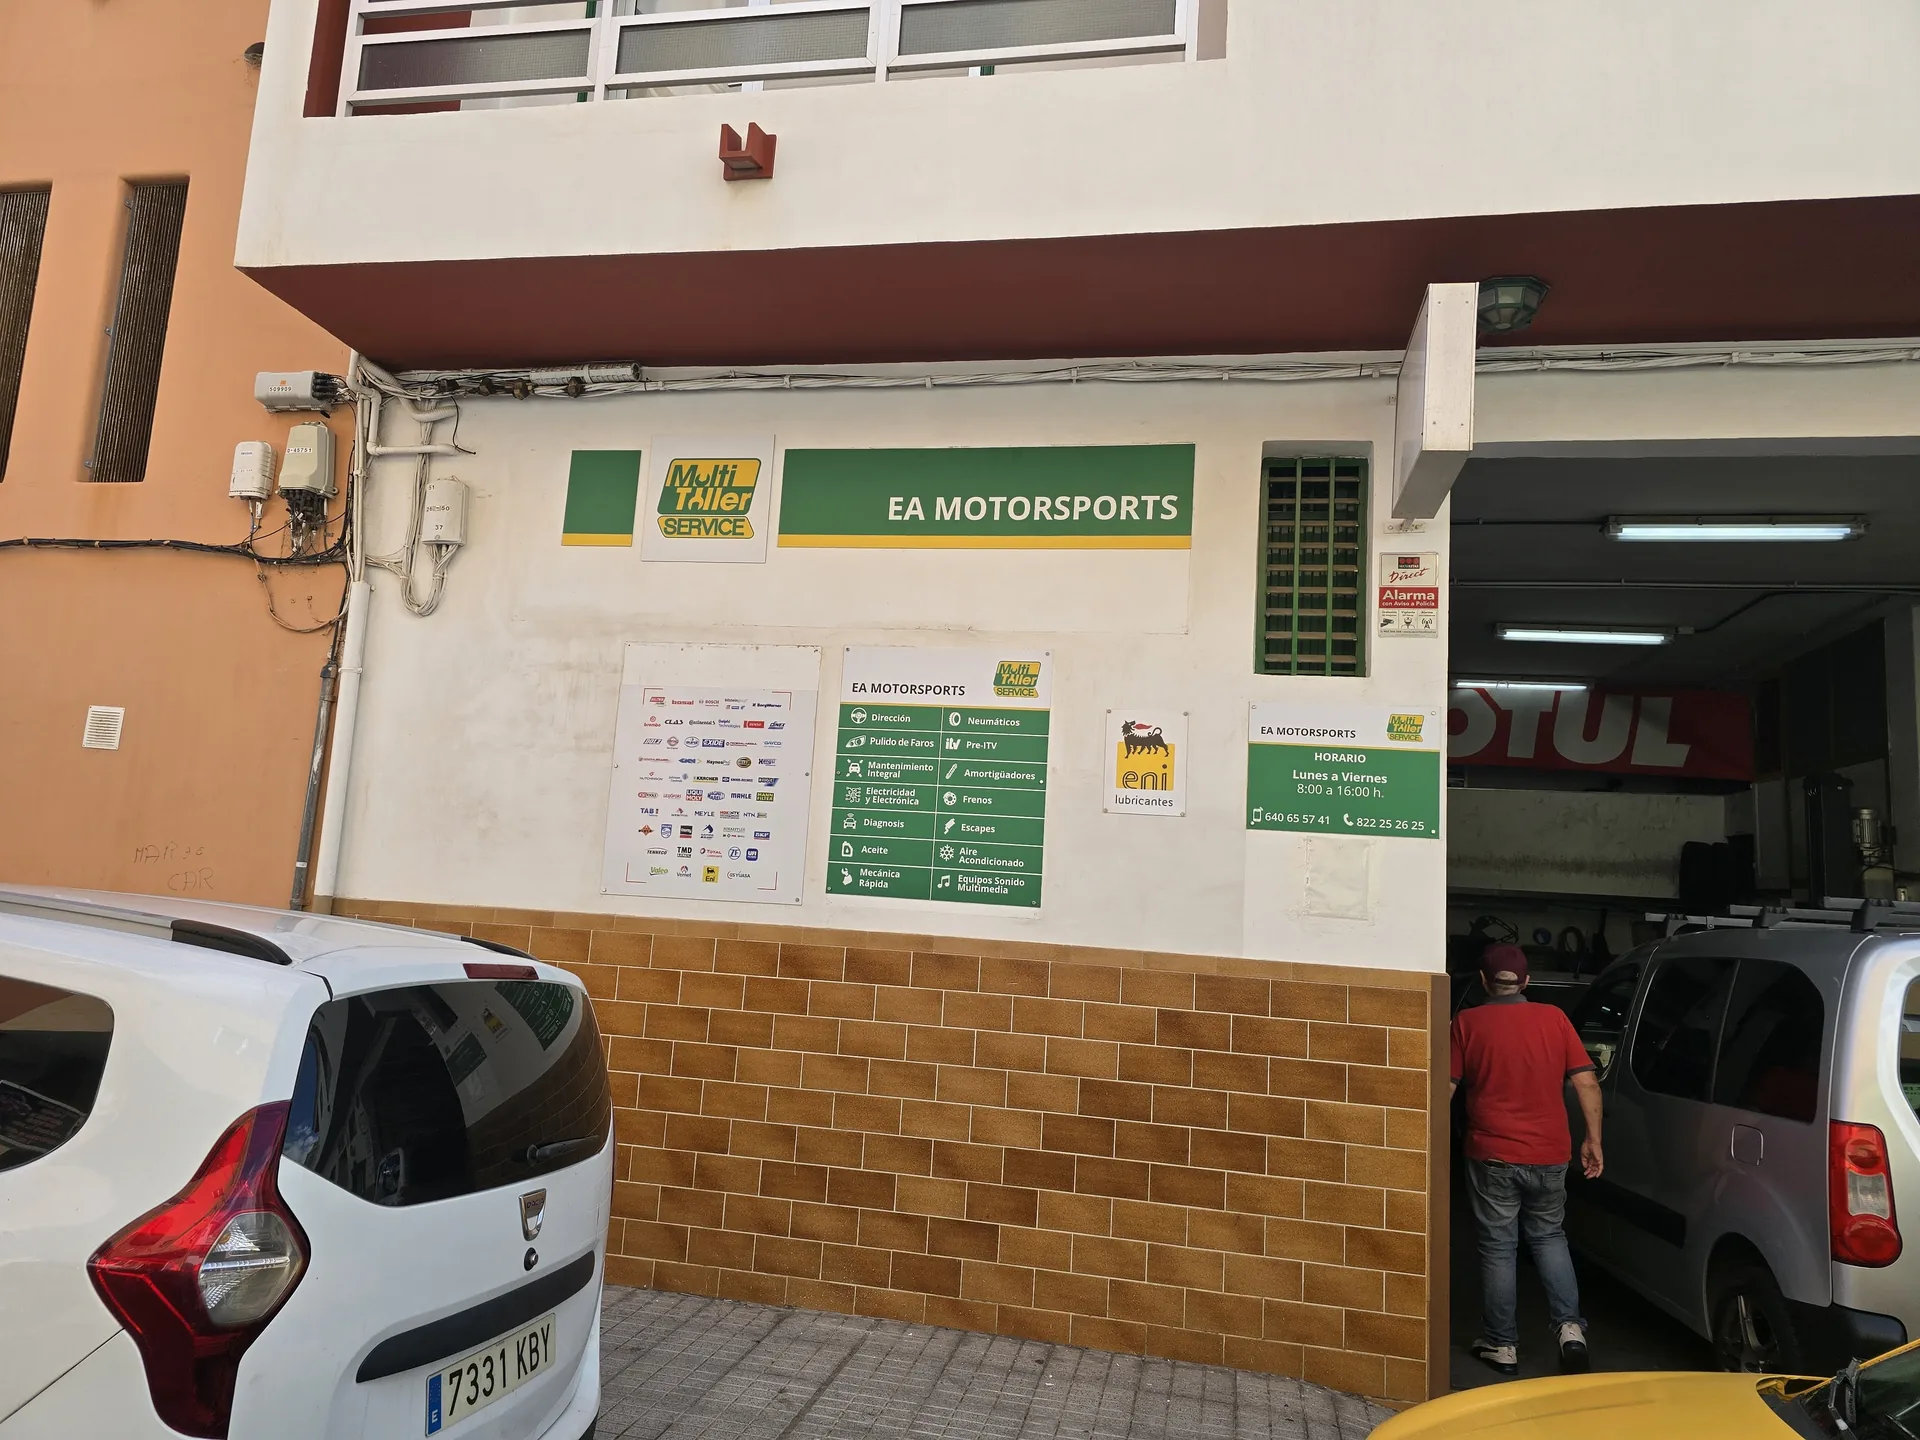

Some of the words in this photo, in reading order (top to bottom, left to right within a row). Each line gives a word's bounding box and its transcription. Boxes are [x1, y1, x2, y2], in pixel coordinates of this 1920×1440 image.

[669, 464, 738, 487] Multi
[675, 487, 753, 512] Taller
[887, 495, 926, 521] EA
[934, 493, 1179, 521] MOTORSPORTS
[663, 517, 746, 536] SERVICE
[1388, 567, 1431, 584] Direct
[1382, 588, 1436, 601] Alarma
[1000, 663, 1030, 675] Multi
[851, 682, 868, 694] EA
[870, 683, 966, 697] MOTORSPORTS
[995, 687, 1035, 697] SERVICE
[870, 713, 912, 723] Dirección
[967, 716, 1021, 727] Neumáticos
[1391, 715, 1416, 725] Multi
[1260, 726, 1274, 735] EA
[1276, 726, 1357, 739] MOTORSPORTS
[1389, 733, 1420, 742] SERVICE
[869, 736, 898, 747] Pulido
[897, 737, 910, 747] de
[910, 738, 935, 748] Faros
[966, 740, 998, 750] Pre-ITV
[1313, 752, 1367, 764] HORARIO
[867, 760, 935, 772] Mantenimiento
[867, 769, 901, 780] Integral
[963, 768, 1036, 781] Amortigüadores
[1121, 763, 1168, 792] eni
[1292, 769, 1329, 781] Lunes
[1331, 773, 1339, 782] a
[1341, 771, 1388, 784] Viernes
[865, 786, 916, 797] Electricidad
[1296, 783, 1323, 796] 8:00
[1325, 786, 1333, 796] a
[1336, 785, 1370, 797] 16:00
[1373, 786, 1385, 799] h.
[864, 797, 871, 805] y
[871, 795, 920, 806] Electrónica
[962, 795, 993, 805] Frenos
[1114, 794, 1174, 807] lubricantes
[863, 818, 905, 829] Diagnosis
[1264, 812, 1285, 822] 640
[1286, 813, 1301, 823] 65
[1301, 814, 1316, 824] 57
[1317, 815, 1331, 825] 41
[1356, 817, 1377, 828] 822
[1379, 818, 1393, 829] 25
[1395, 819, 1409, 830] 26
[1411, 820, 1425, 831] 25
[960, 823, 996, 835] Escapes
[677, 846, 693, 854] TMD
[860, 845, 889, 855] Aceite
[959, 846, 978, 856] Aire
[958, 855, 1025, 867] Acondicionado
[859, 868, 901, 879] Mecánica
[858, 879, 889, 890] Rápida
[957, 874, 993, 885] Equipos
[994, 876, 1026, 887] Sonido
[957, 883, 1009, 895] Multimedia
[449, 1348, 506, 1417] 7331
[516, 1323, 551, 1380] KBY
[430, 1408, 439, 1424] E
